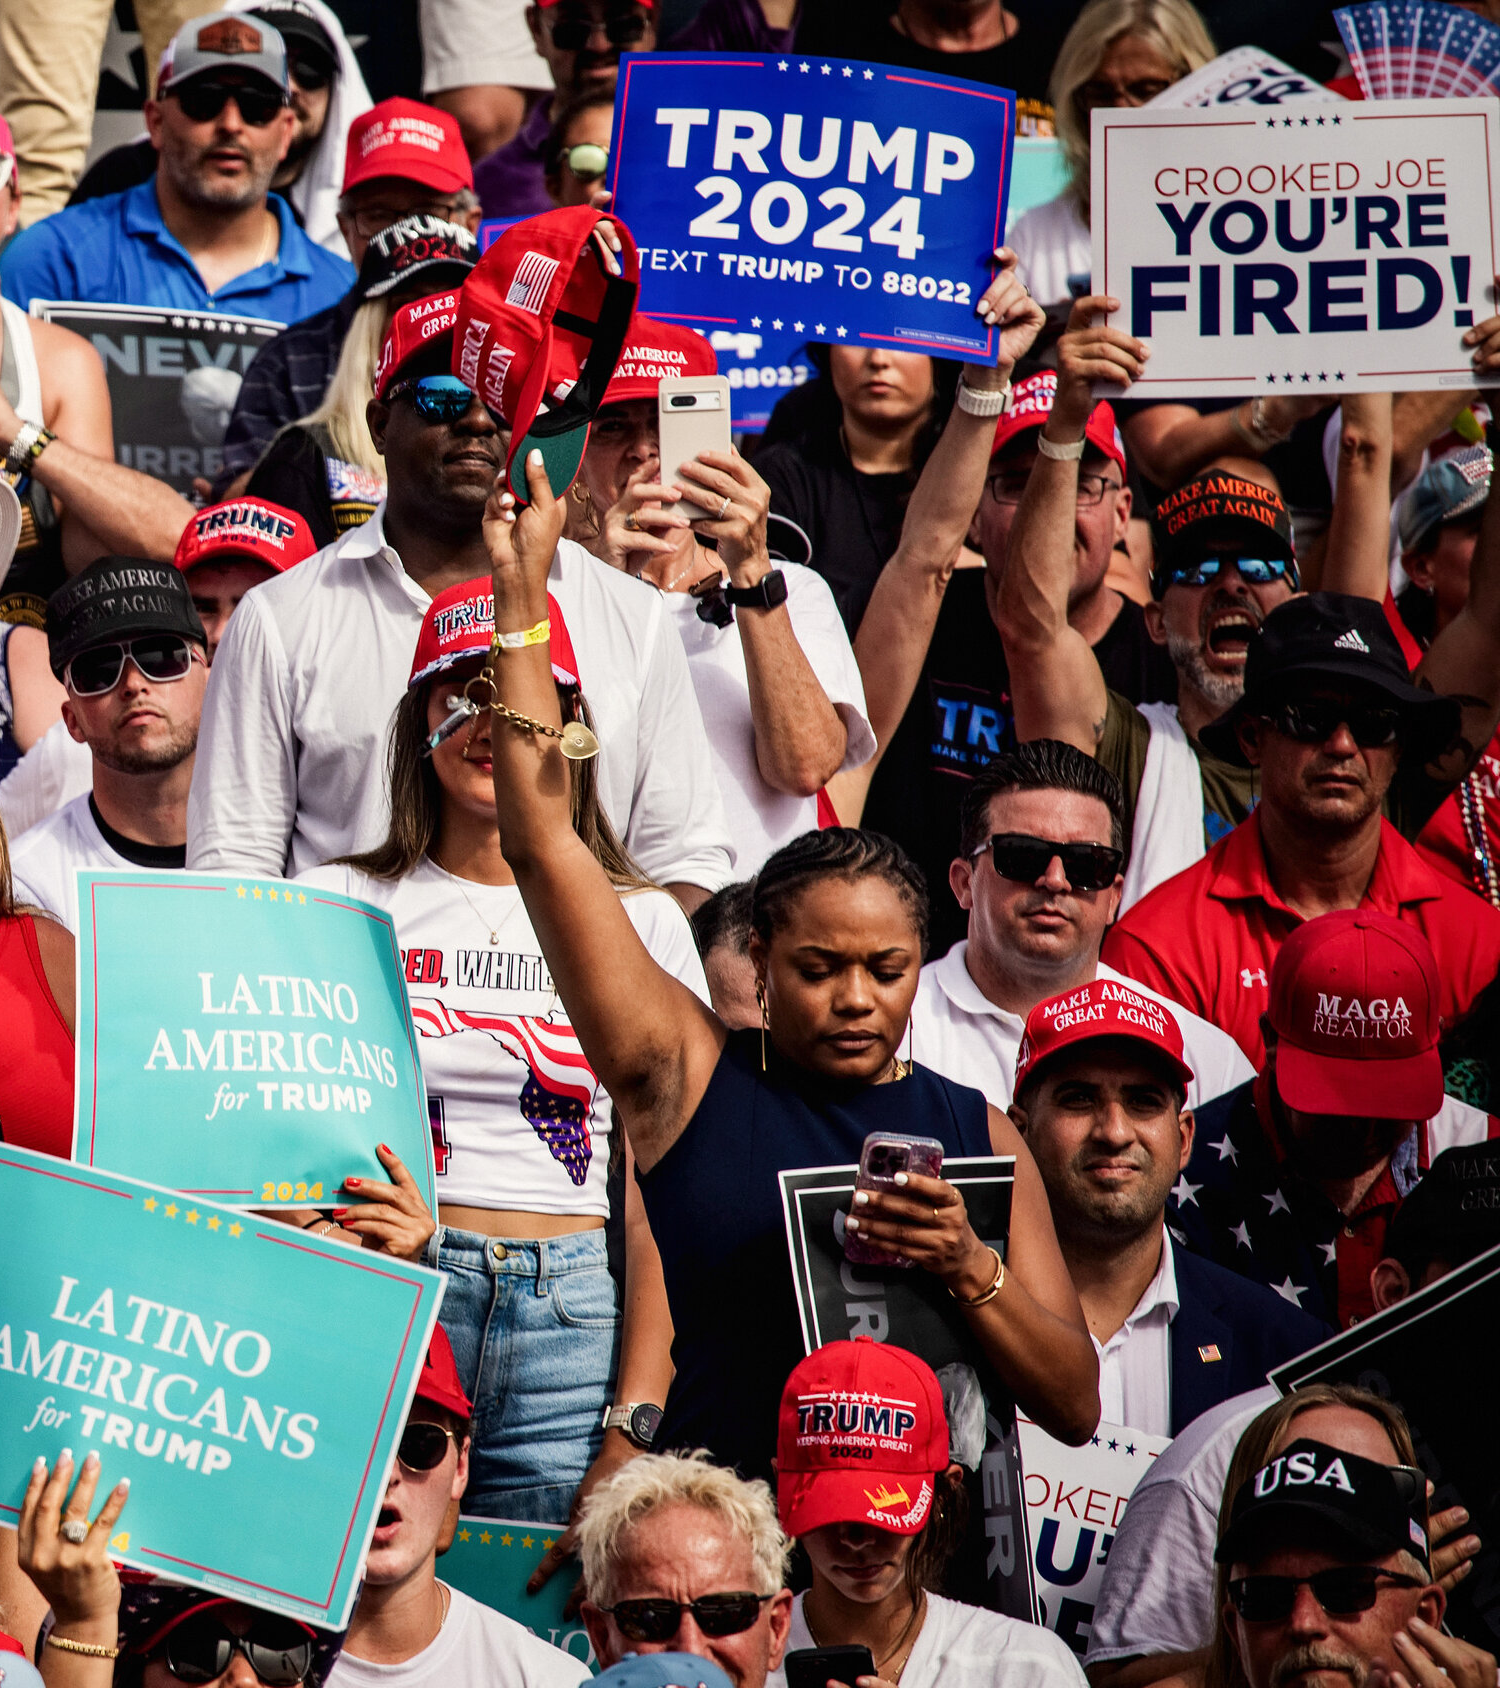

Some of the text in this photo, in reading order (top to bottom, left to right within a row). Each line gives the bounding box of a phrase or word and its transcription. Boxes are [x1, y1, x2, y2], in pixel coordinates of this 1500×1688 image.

[388, 117, 445, 143] AMERICA
[399, 131, 441, 153] AGAIN
[656, 107, 975, 196] TRUMP
[1155, 158, 1447, 196] CROOKED JOE
[368, 214, 477, 258] TRUMP
[689, 176, 925, 260] 2024
[1156, 193, 1449, 255] YOU'RE
[636, 247, 972, 305] TEXT TRUMP TO 88022
[409, 295, 455, 323] MAKE
[1131, 255, 1474, 337] FIRED!
[92, 333, 258, 379] NEV
[612, 364, 682, 379] EAT AGAIN
[623, 347, 688, 365] AMERICA
[1009, 395, 1054, 419] TRU
[1157, 477, 1285, 521] MAKE AMERICA
[1167, 498, 1277, 535] GREAT AGAIN
[196, 508, 295, 540] TRUMP
[100, 568, 181, 597] AMERICA
[121, 594, 174, 616] AGAIN
[434, 594, 495, 637] TRU
[439, 622, 495, 647] KEEP AMERI
[1334, 637, 1370, 653] adidas
[931, 744, 967, 763] MAKE
[401, 949, 449, 988] ED,
[198, 971, 360, 1024] LATINO
[1043, 983, 1169, 1026] MAKE AMERICA
[1316, 992, 1413, 1020] MAGA
[1054, 1003, 1165, 1037] GREAT AGAIN
[1313, 1013, 1413, 1039] REALTOR
[144, 1026, 399, 1089] AMERICANS
[206, 1082, 372, 1120] for TRUMP
[1451, 1158, 1500, 1181] MAK
[261, 1181, 324, 1202] 2024
[50, 1276, 272, 1379] LATINO
[25, 1396, 232, 1475] for TRUMP
[798, 1402, 917, 1439] TRUMP
[797, 1434, 830, 1447] KEEPING
[832, 1435, 877, 1447] AMERICA
[829, 1446, 873, 1459] 2020
[1254, 1451, 1356, 1499] USA
[867, 1479, 933, 1528] 45TH PRESIDENT
